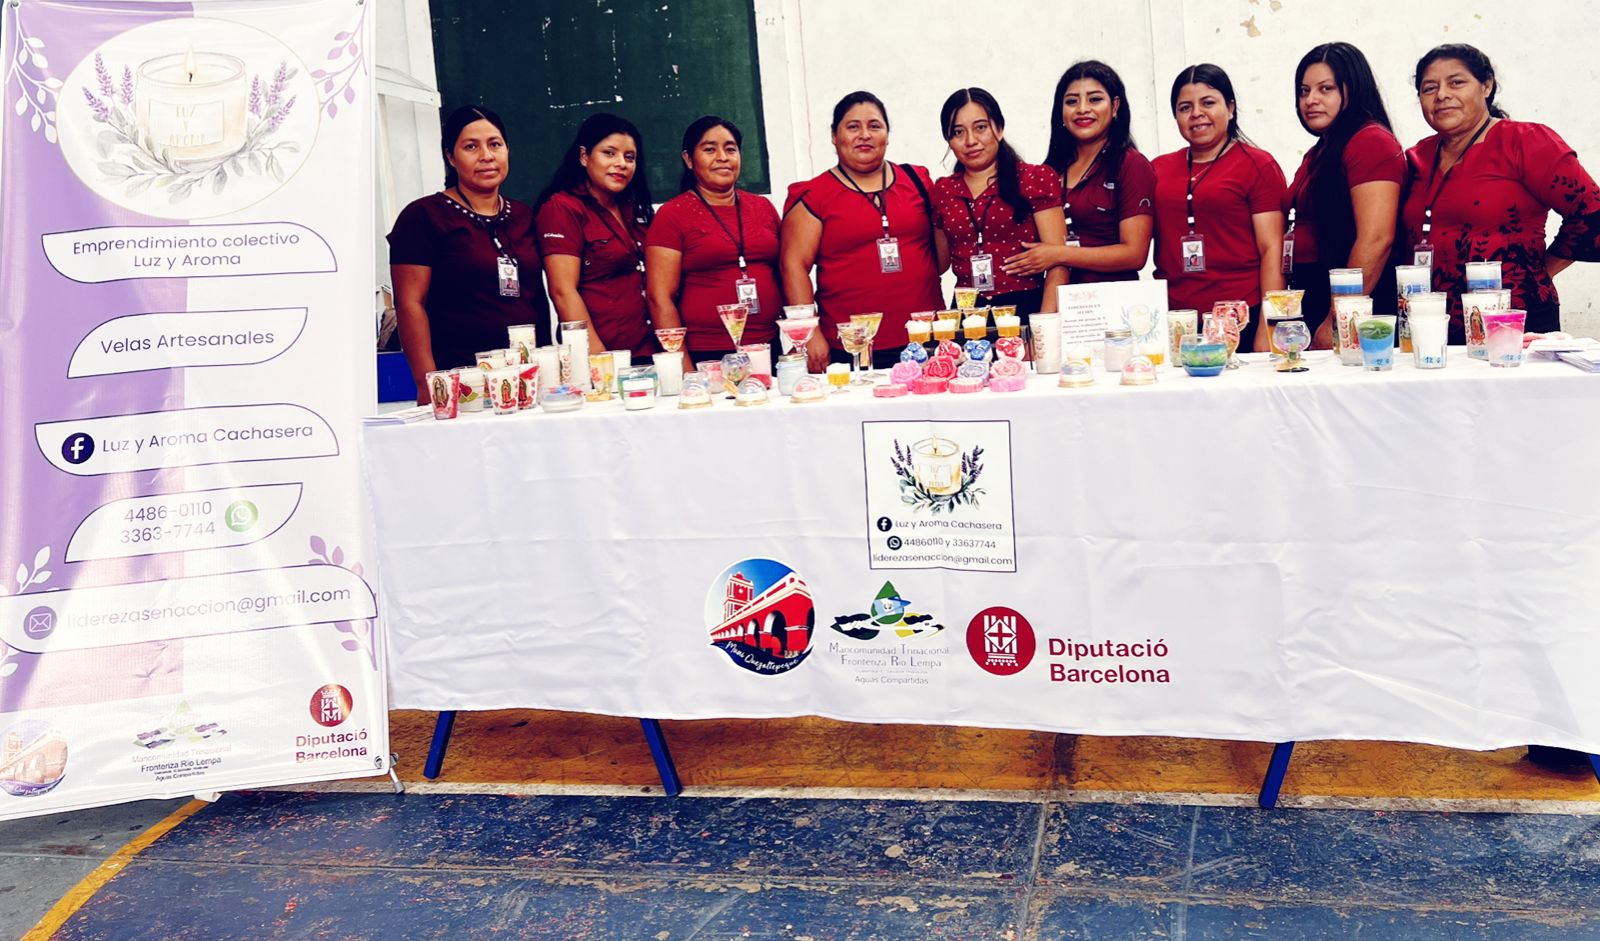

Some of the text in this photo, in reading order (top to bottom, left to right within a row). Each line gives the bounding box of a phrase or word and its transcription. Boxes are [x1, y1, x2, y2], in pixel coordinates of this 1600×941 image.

[73, 232, 300, 255] Emprendimiento colectivo
[134, 253, 241, 270] Luz y Aroma
[101, 331, 274, 354] Velas Artesanales
[102, 423, 313, 454] Luz y Aroma Cachasera
[124, 501, 212, 523] 4486-0110
[120, 521, 216, 544] 3363-7744
[895, 520, 1003, 530] Luz y Aroma Cachasera
[904, 537, 996, 548] 44860110 y 33637744
[873, 553, 1013, 566] liderezasenaccion@gmail.com
[67, 587, 351, 629] liderezasenaccion@gmail.com
[1048, 638, 1168, 661] Diputació
[1050, 663, 1170, 683] Barcelona
[296, 728, 368, 749] Diputació
[296, 745, 368, 764] Barcelona
